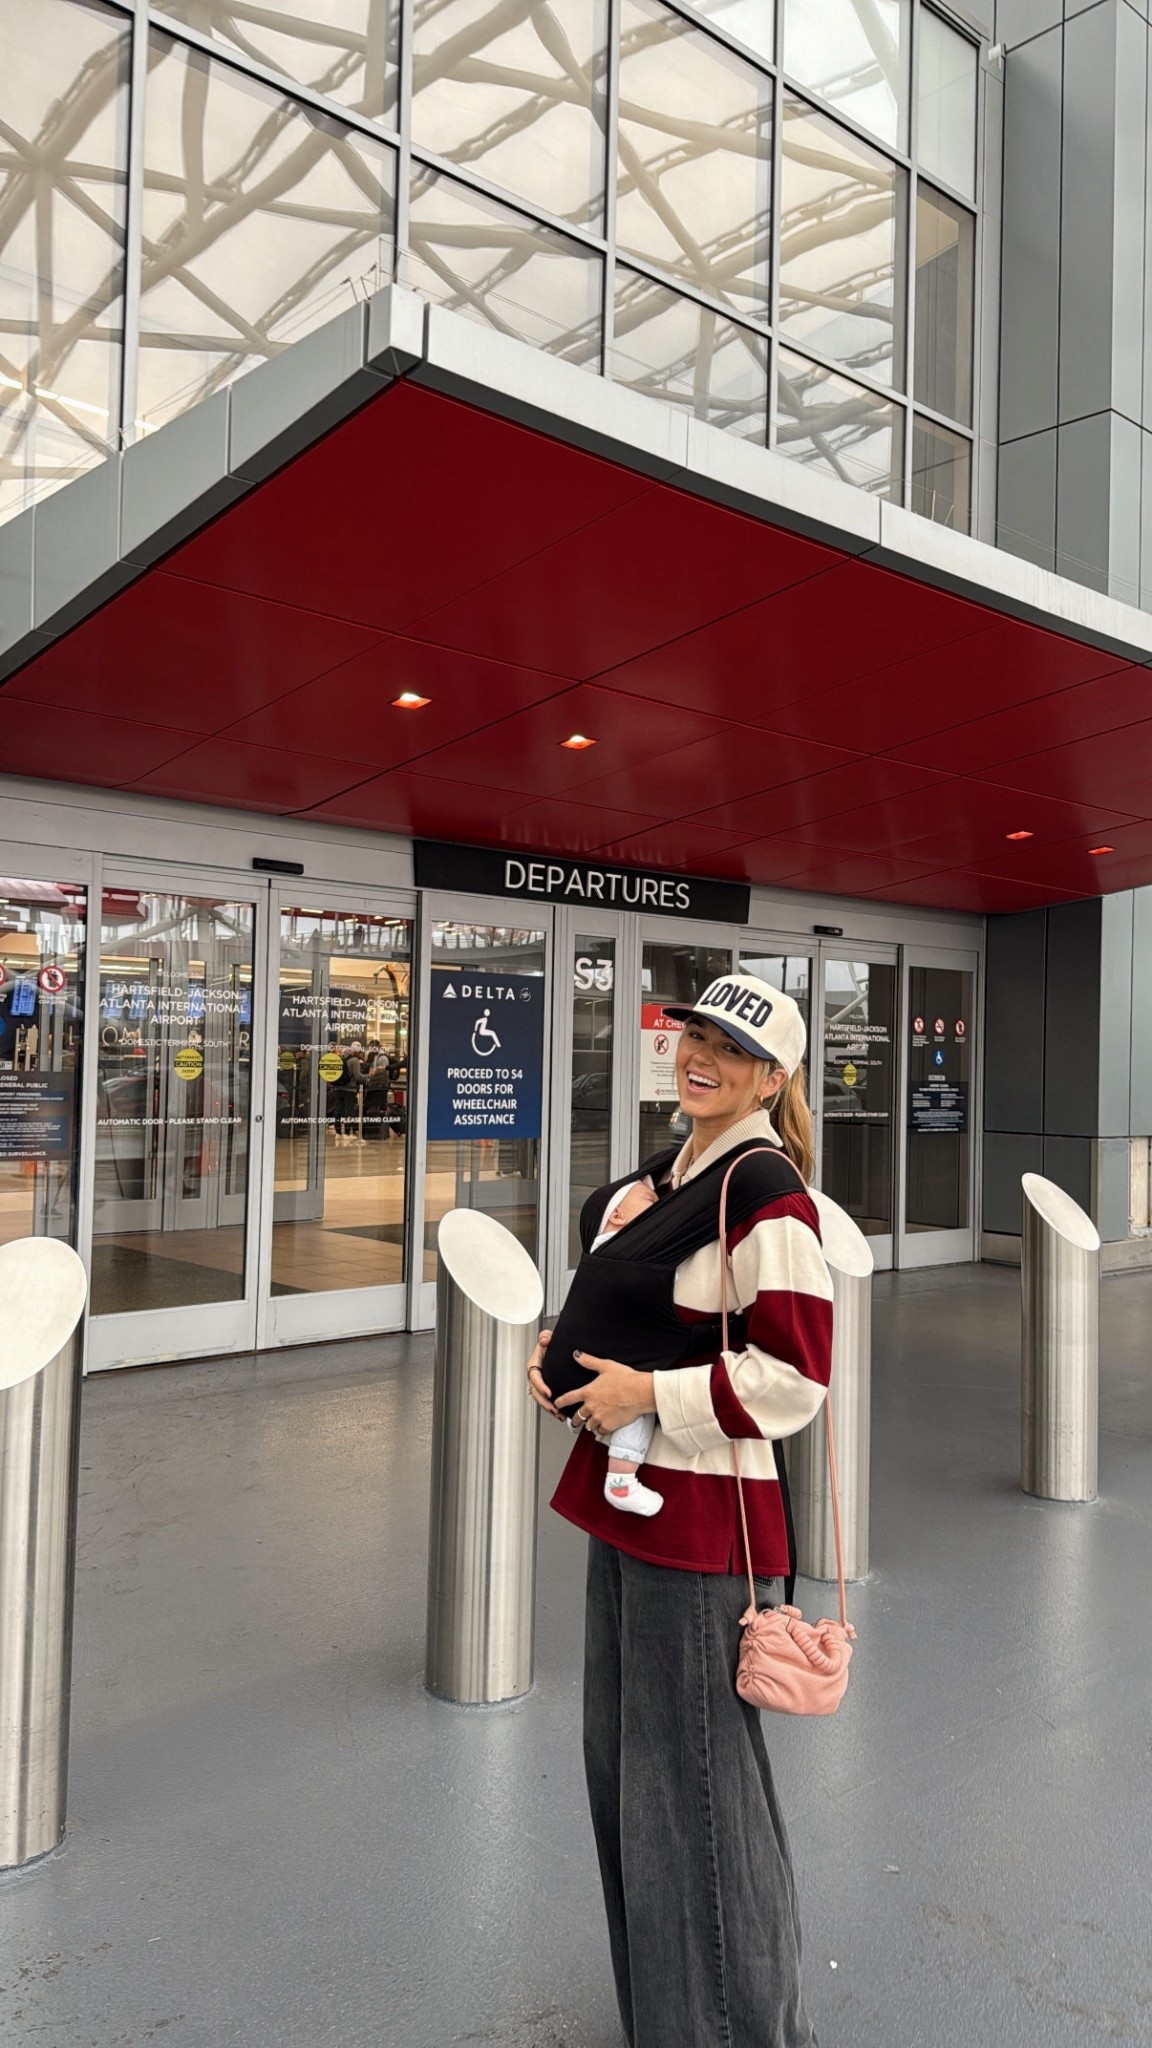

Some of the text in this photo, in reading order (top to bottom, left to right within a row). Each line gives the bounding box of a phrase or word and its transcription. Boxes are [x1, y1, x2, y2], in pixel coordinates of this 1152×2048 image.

[504, 860, 690, 909] DEPARTURES
[574, 957, 614, 991] S3
[112, 984, 239, 1000] HARTSFIELD-JACKSON
[462, 985, 515, 1000] DELTA
[100, 998, 246, 1014] ATLANTA INTERNATIONAL
[292, 995, 399, 1009] HARTSFIELD-JACKSON
[700, 982, 773, 1028] LOVED
[150, 1014, 200, 1025] AIRPORT
[282, 1008, 404, 1022] ATLANTA INTERNATIONAL
[325, 1022, 366, 1033] AIRPORT
[653, 1019, 664, 1028] AT
[121, 1038, 161, 1046] DOMESTIC
[204, 1040, 229, 1048] SOUTH
[447, 1067, 523, 1079] PROCEED TO S4
[457, 1083, 514, 1095] DOORS FOR
[452, 1099, 517, 1110] WHEELCHAIR
[454, 1114, 515, 1125] ASSISTANCE
